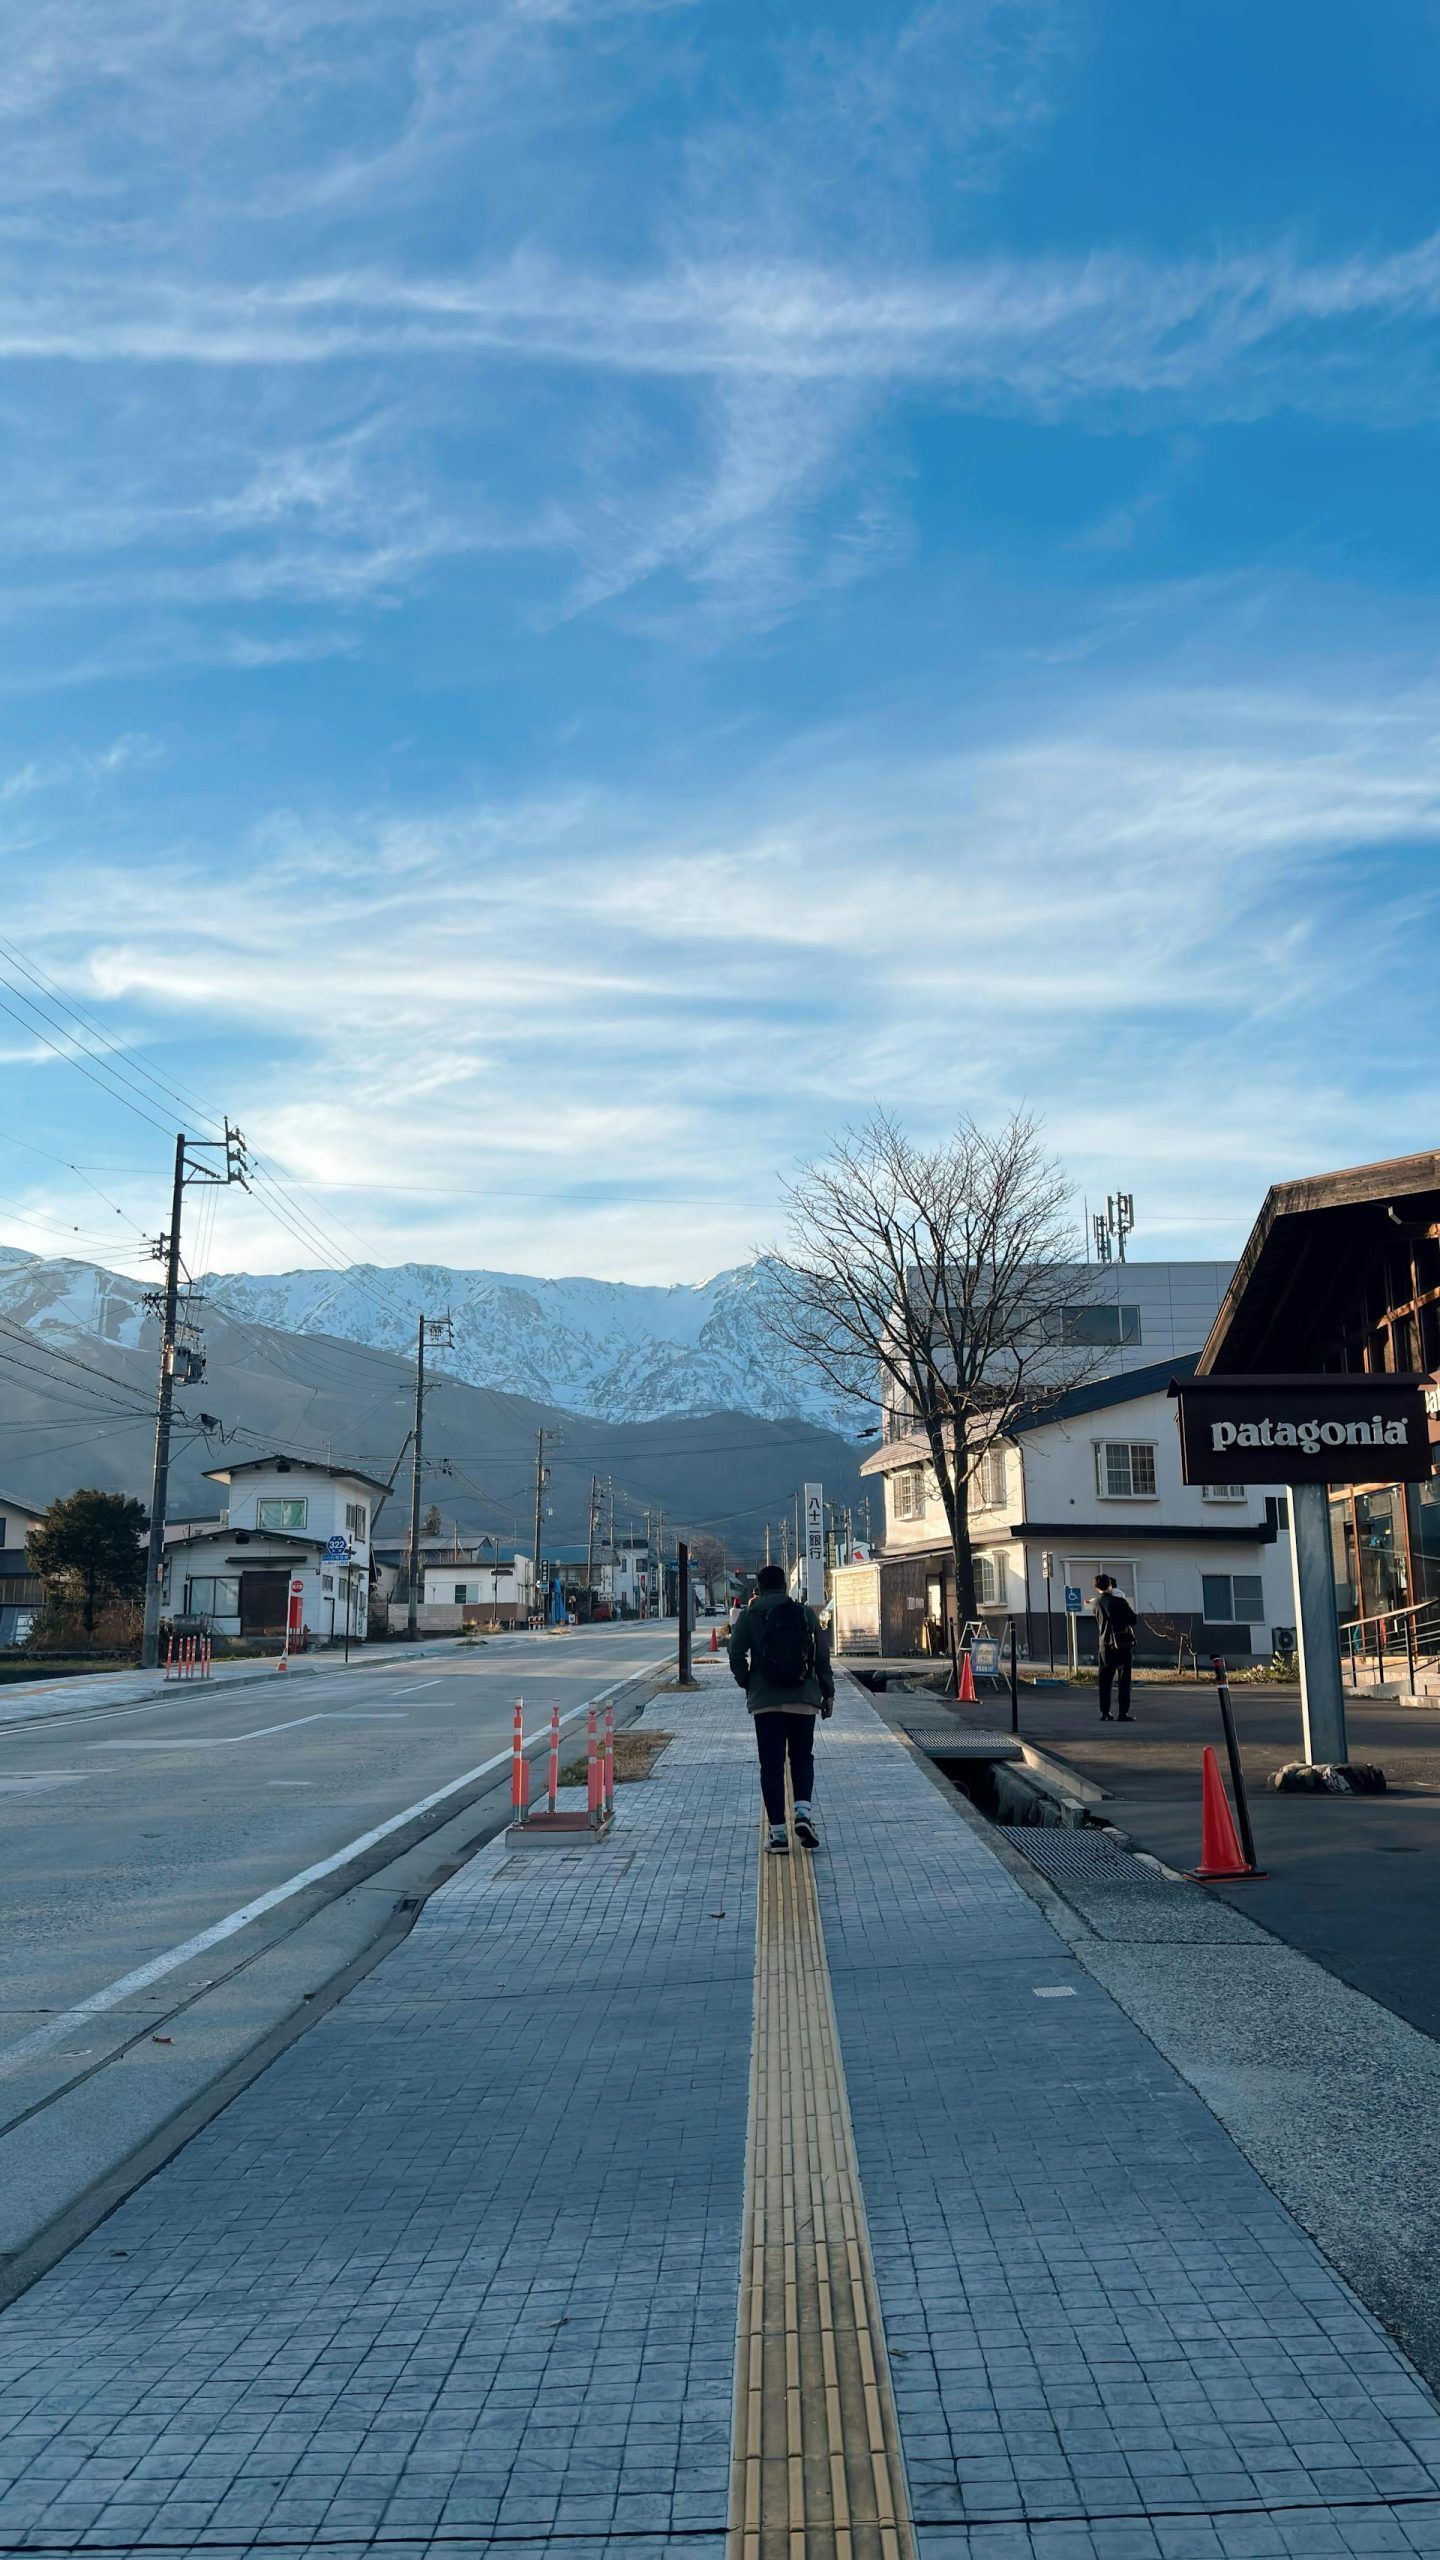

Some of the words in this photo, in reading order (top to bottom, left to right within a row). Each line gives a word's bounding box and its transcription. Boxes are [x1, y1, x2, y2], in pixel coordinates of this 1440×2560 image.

[1211, 1415, 1408, 1454] patagonia
[329, 1540, 345, 1549] 322
[809, 1497, 821, 1559] 八十二銀行
